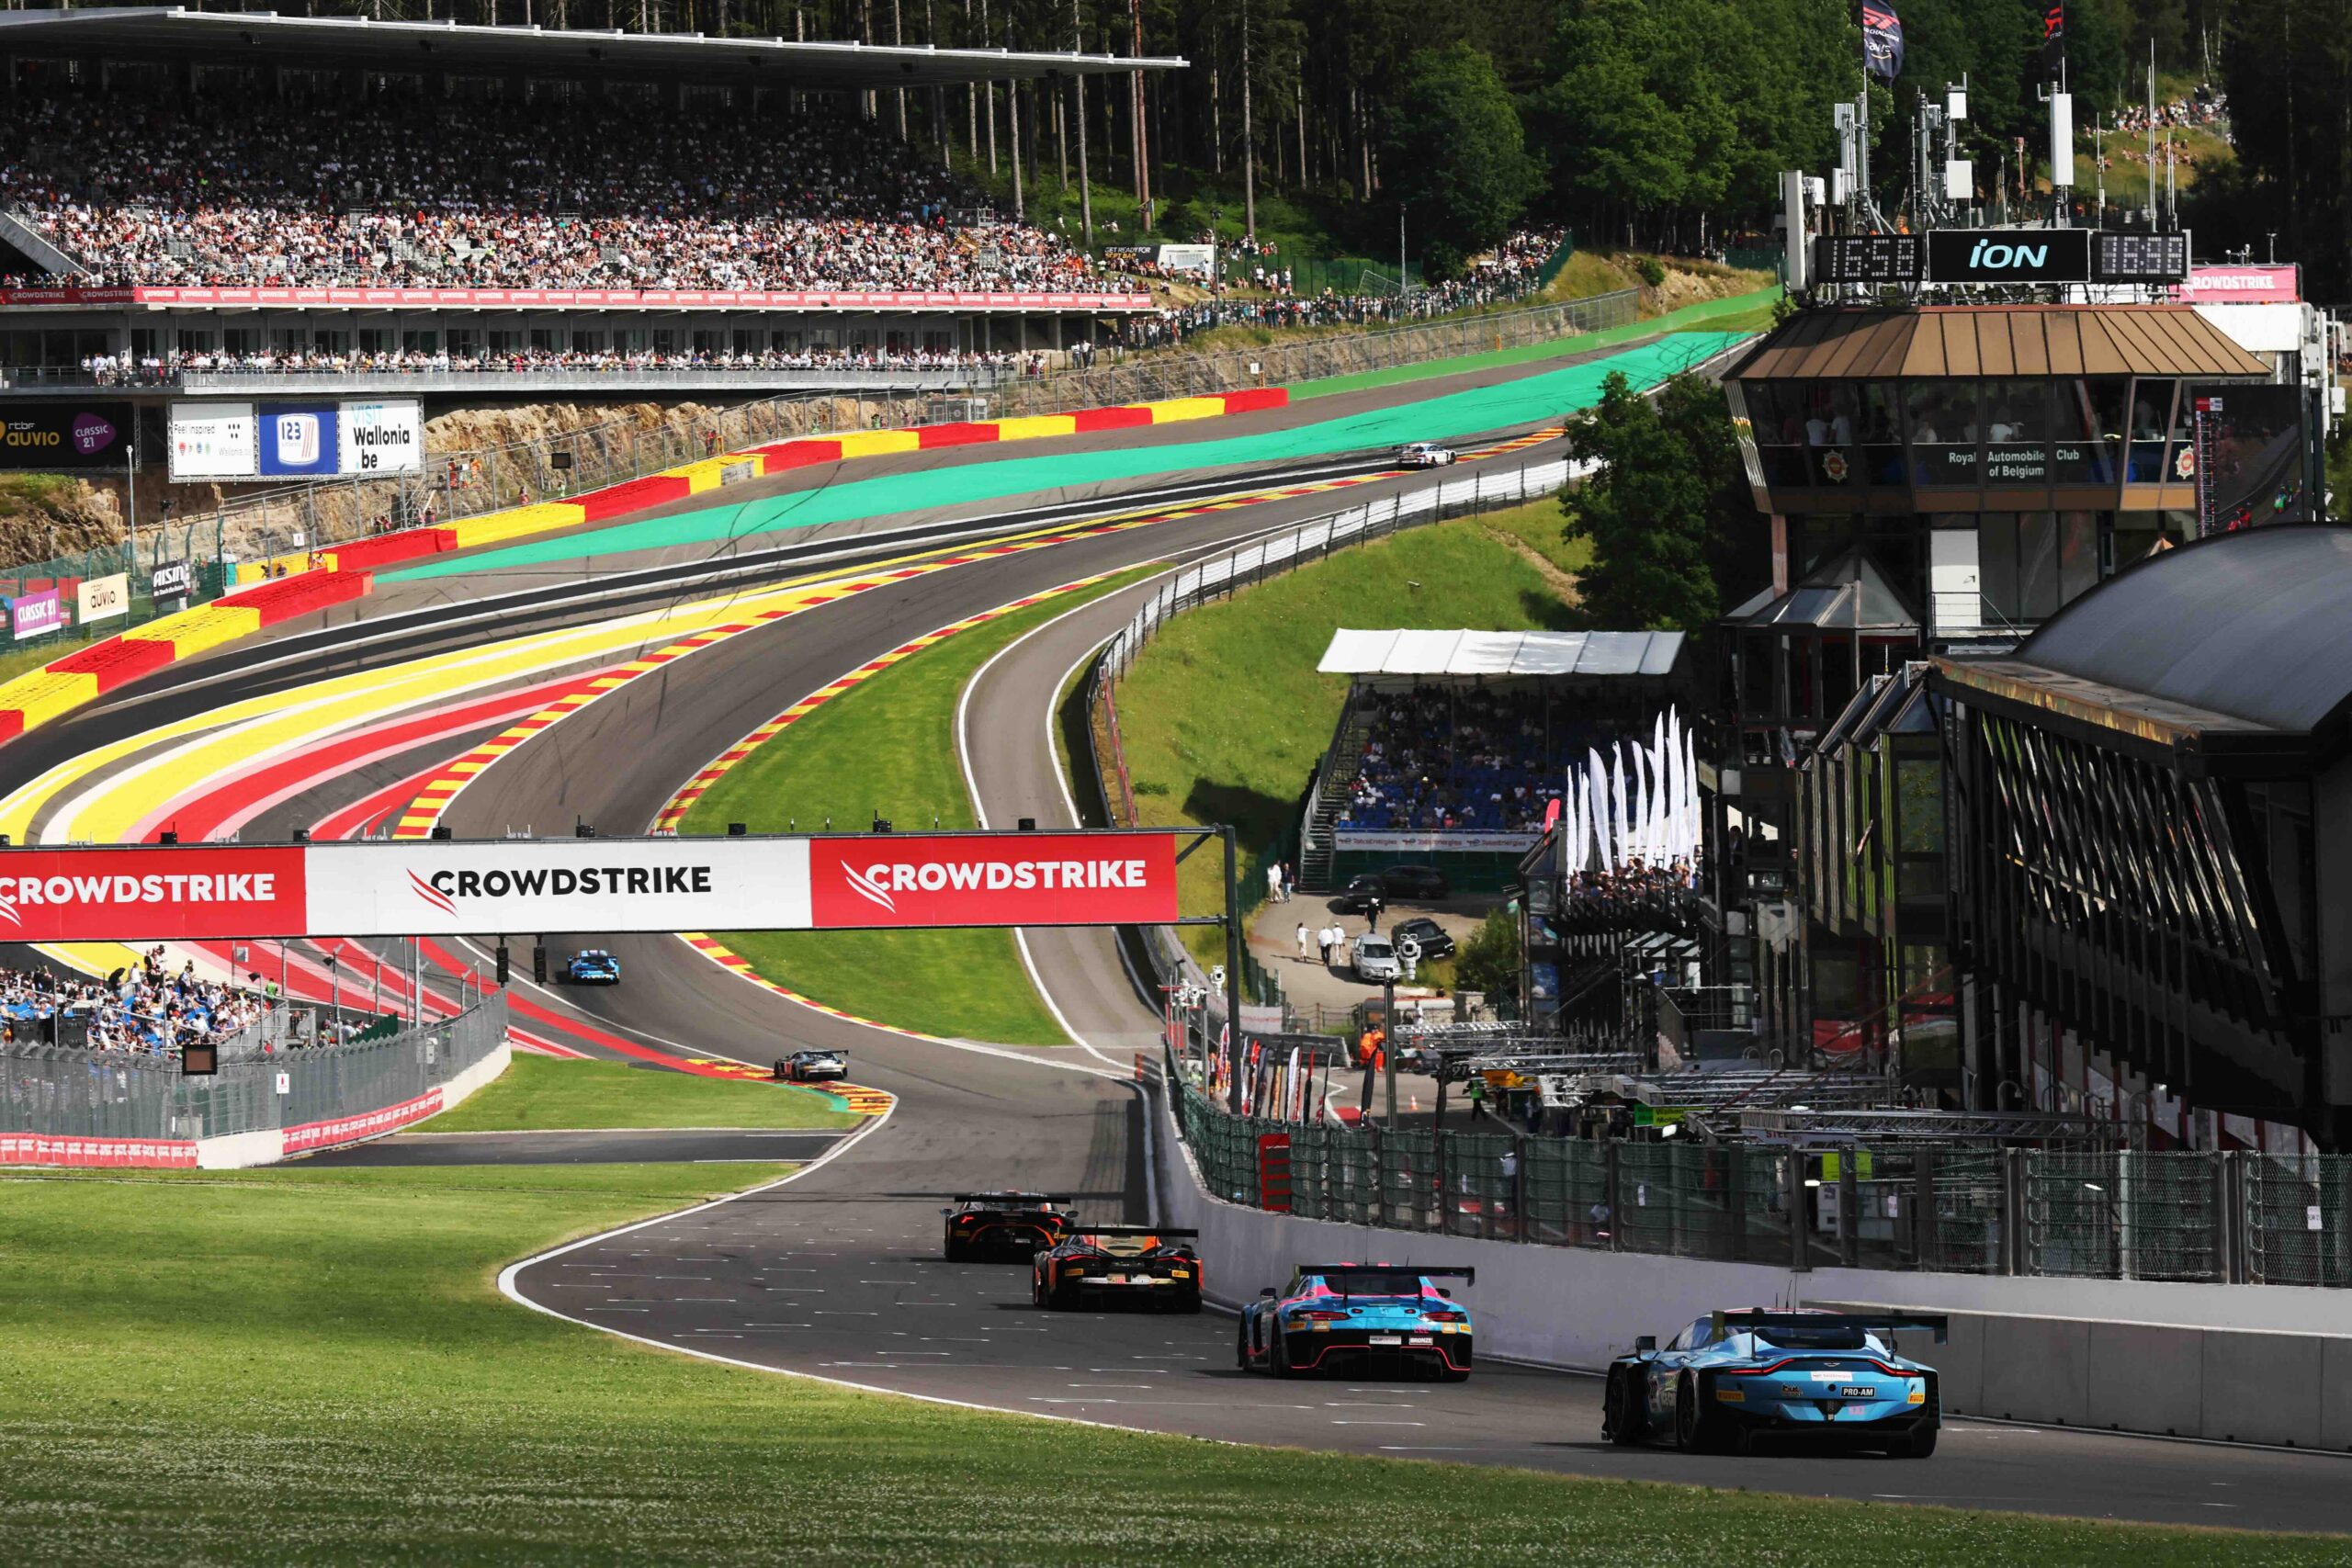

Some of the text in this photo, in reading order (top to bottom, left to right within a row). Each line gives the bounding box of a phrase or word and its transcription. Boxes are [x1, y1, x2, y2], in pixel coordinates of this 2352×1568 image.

[1831, 238, 1915, 277] 16:58
[351, 404, 383, 425] VISIT
[74, 424, 109, 437] CLASSIC
[175, 423, 215, 435] Feel inspired
[281, 422, 301, 440] 123
[353, 423, 410, 446] Wallonia
[83, 437, 95, 447] 21
[1949, 449, 2079, 466] Royal Automobile Club
[1989, 466, 2044, 479] of Belgium
[17, 598, 56, 623] CLASSIC 21
[430, 866, 712, 897] CROWDSTRIKE
[865, 860, 1147, 891] CROWDSTRIKE
[1843, 1388, 1873, 1396] PRO-AM
